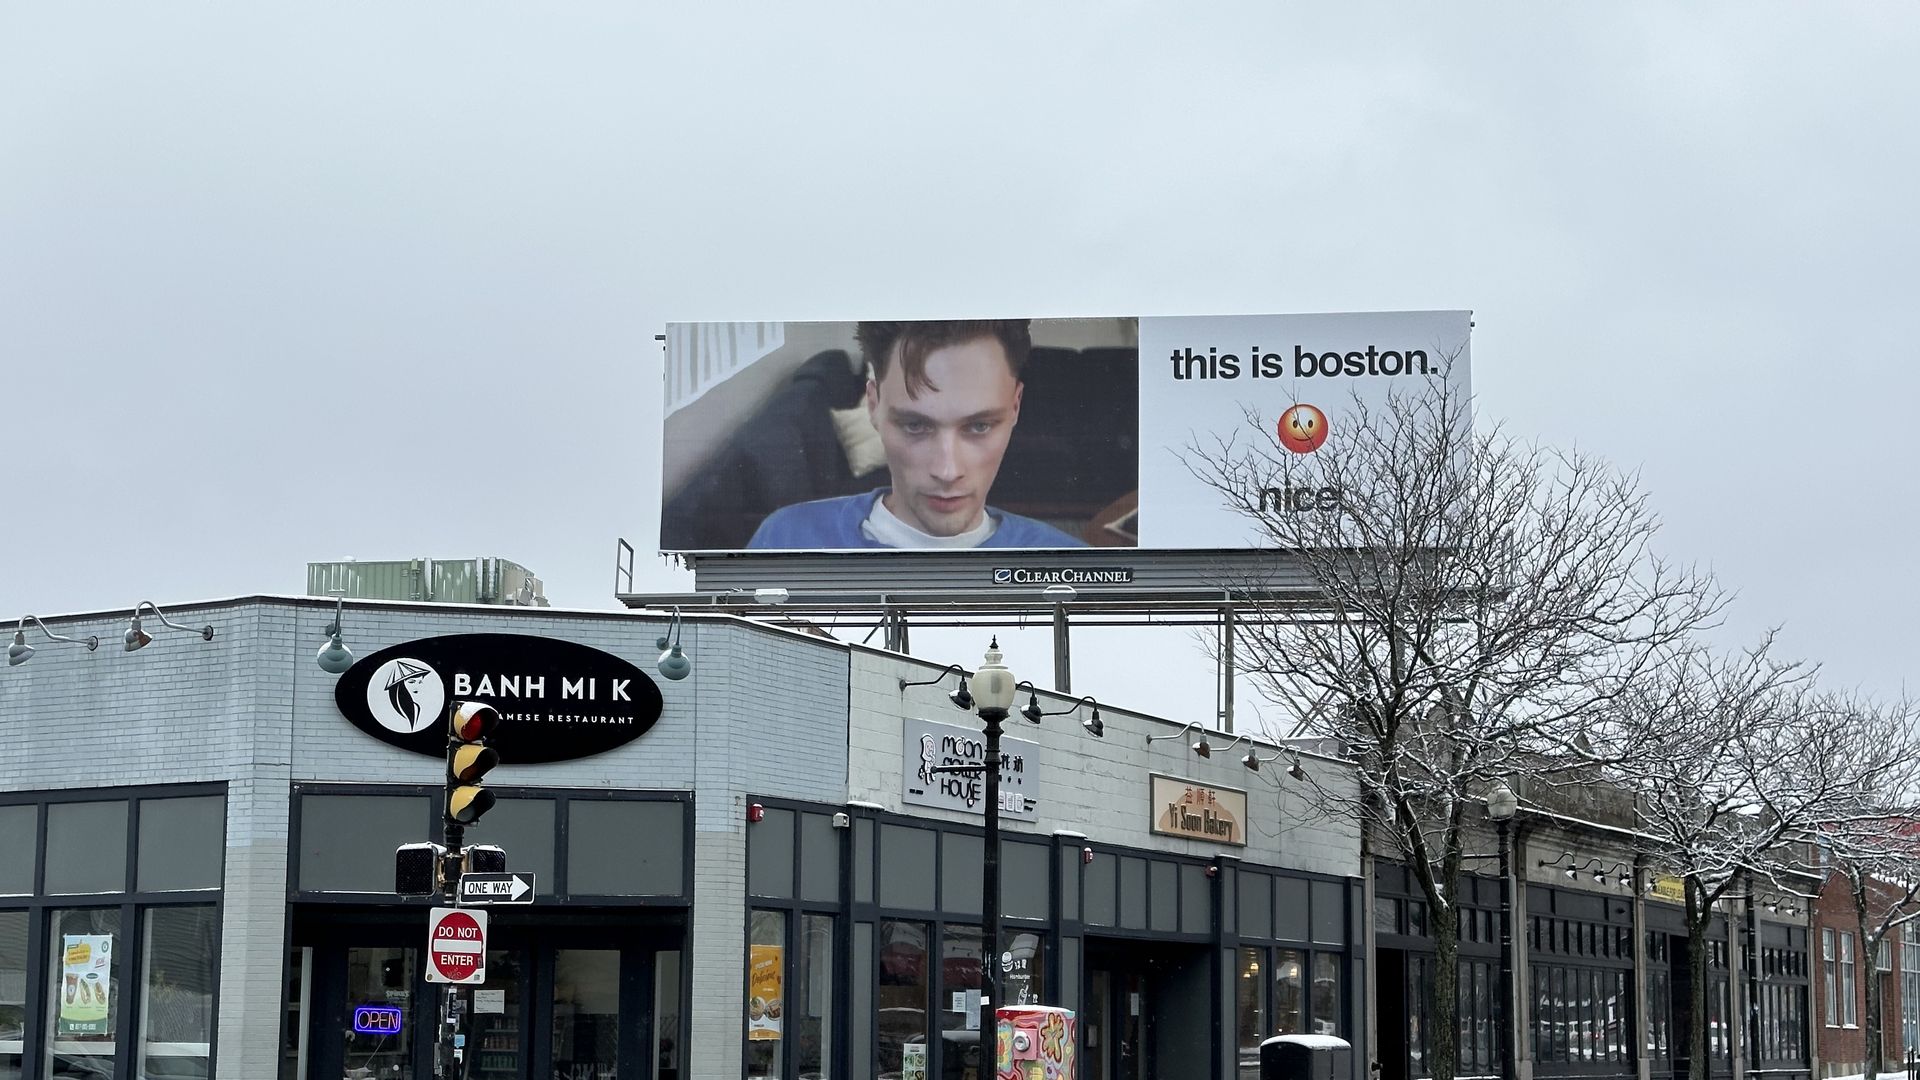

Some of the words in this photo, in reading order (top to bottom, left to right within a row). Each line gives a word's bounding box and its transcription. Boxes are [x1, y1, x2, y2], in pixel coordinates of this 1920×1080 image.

[1170, 347, 1241, 380] this
[1252, 346, 1283, 379] is
[1294, 345, 1439, 378] boston.
[454, 673, 545, 699] BANH
[562, 677, 596, 700] MI
[612, 678, 632, 701] K
[548, 714, 634, 725] RESTAURANT
[1168, 802, 1178, 829] Yi
[1180, 804, 1202, 832] Soon
[1203, 808, 1233, 842] Bakery
[468, 883, 488, 894] ONE
[492, 883, 513, 894] WAY
[438, 926, 454, 938] DO
[457, 927, 479, 939] NOT
[440, 955, 474, 966] ENTER
[357, 1010, 398, 1030] OPEN
